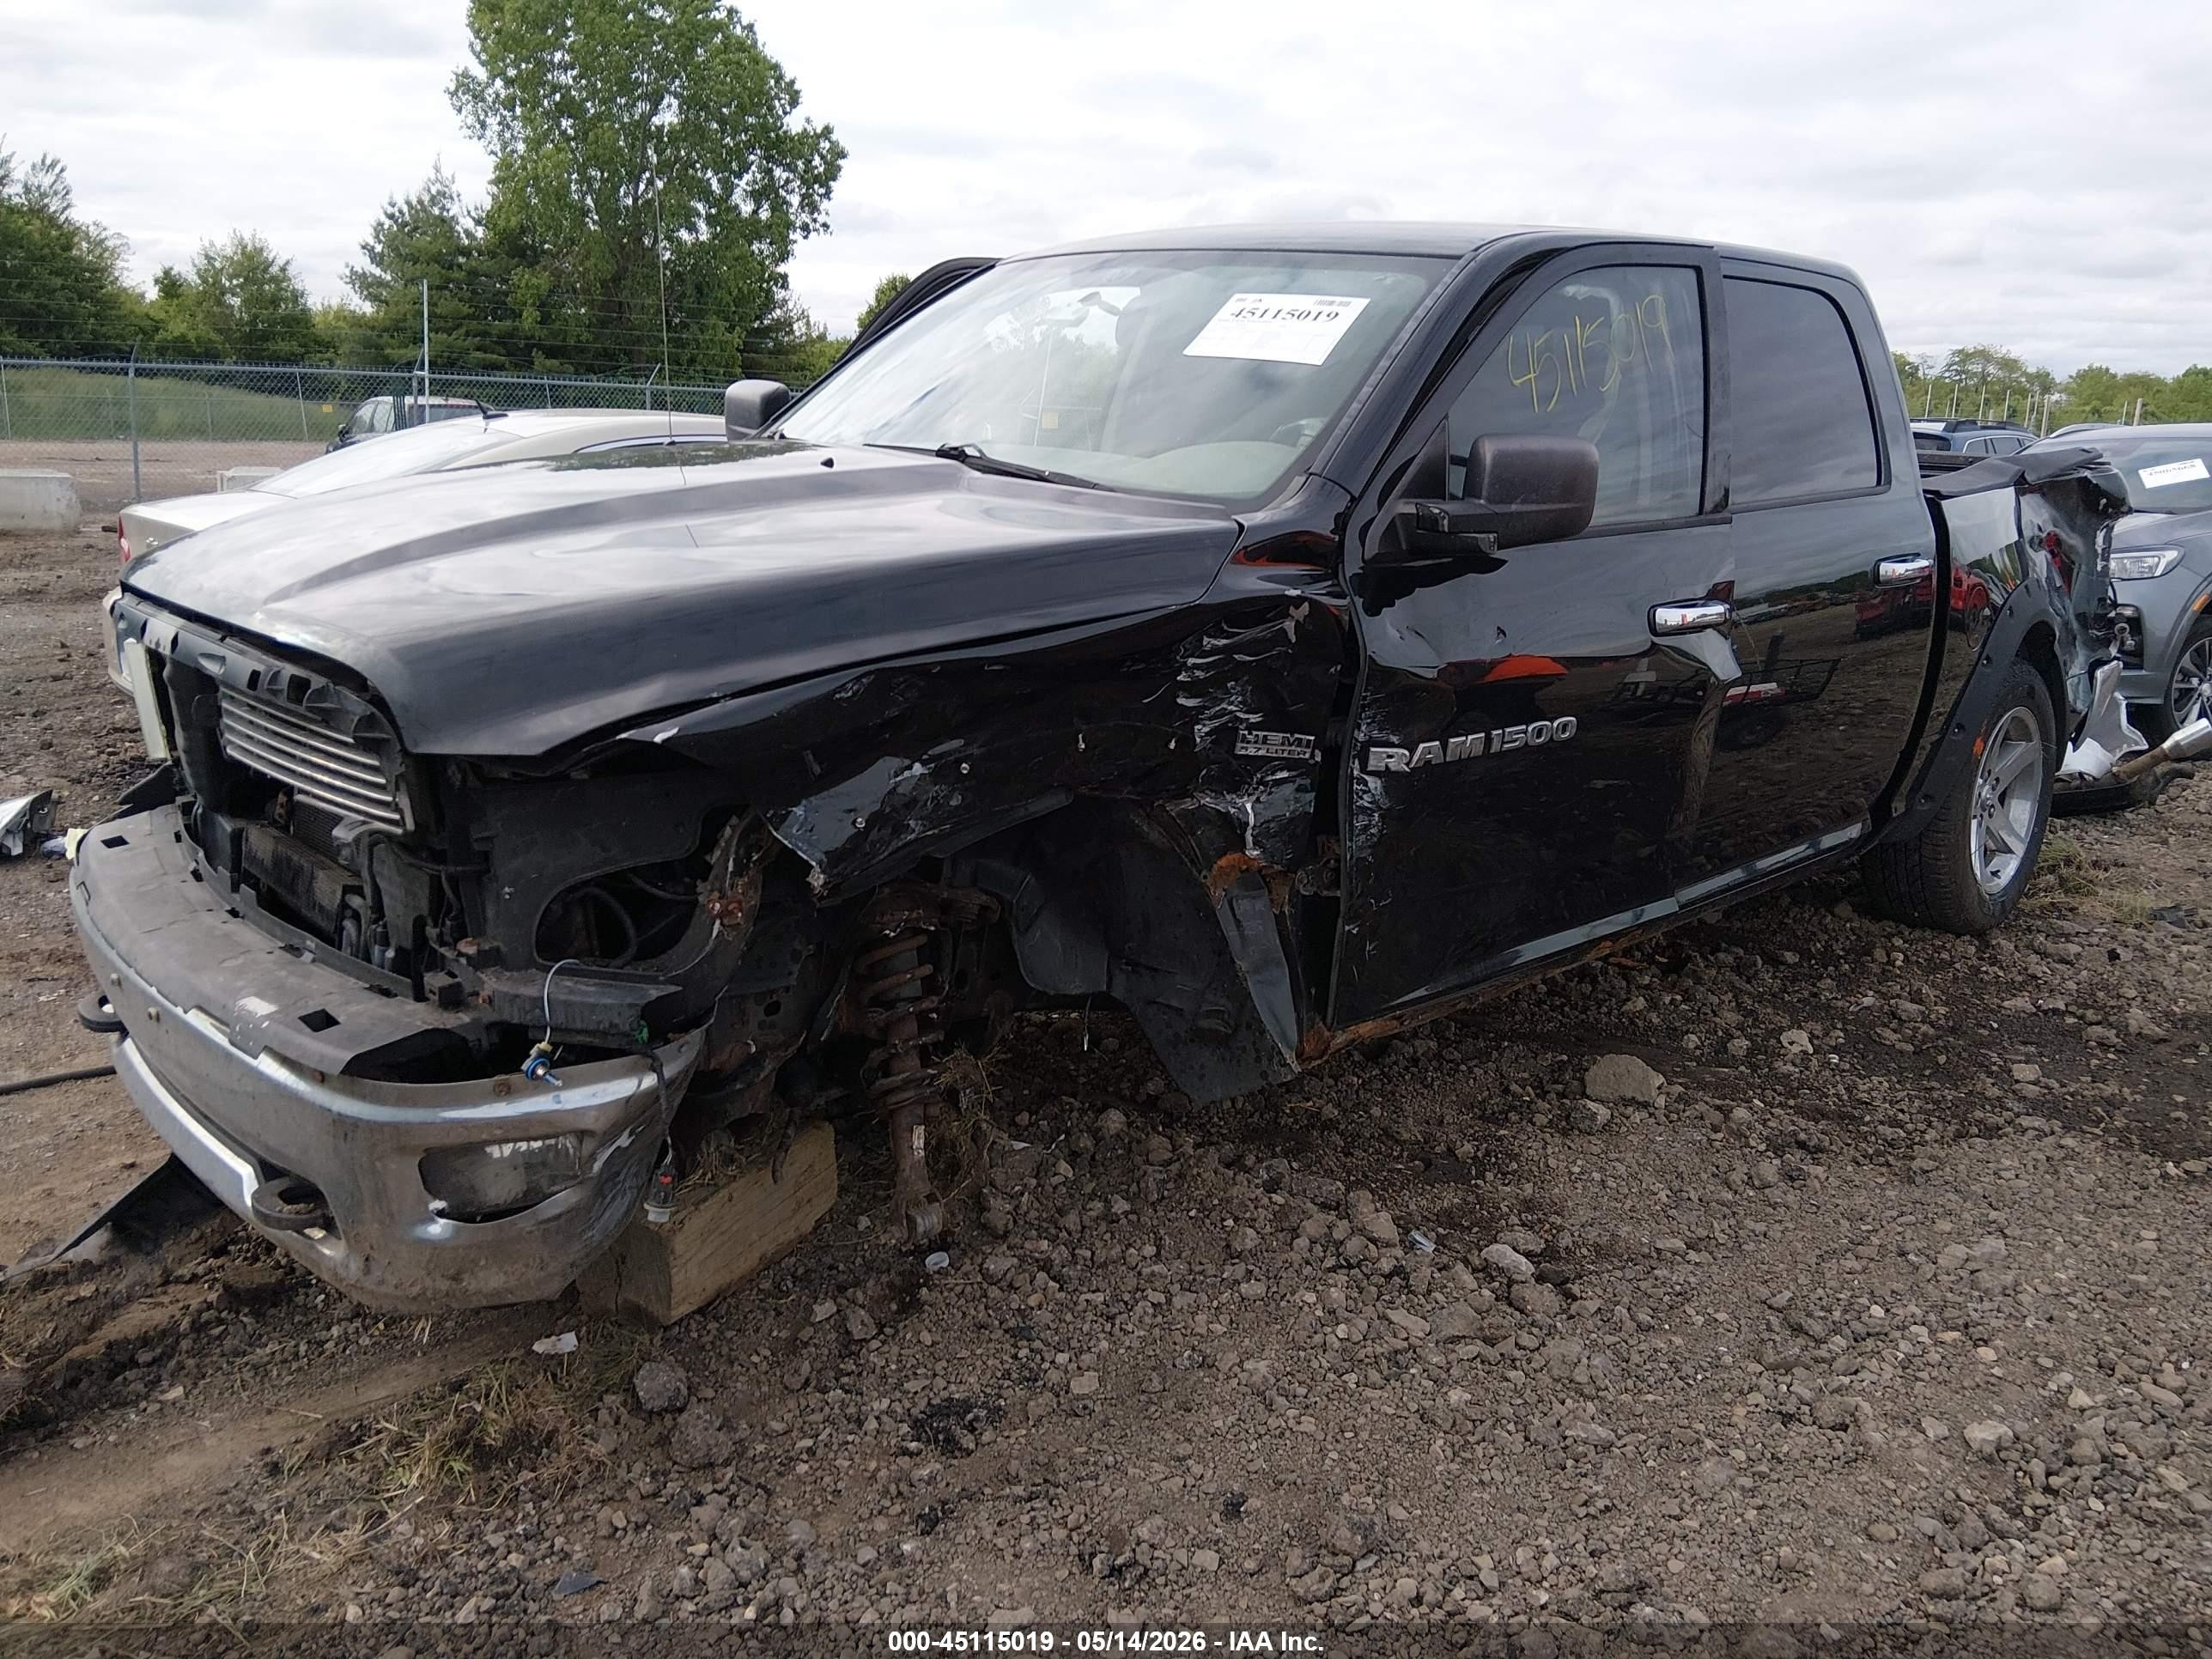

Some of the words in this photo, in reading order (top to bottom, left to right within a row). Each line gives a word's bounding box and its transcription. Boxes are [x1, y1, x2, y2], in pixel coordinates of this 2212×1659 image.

[1231, 307, 1340, 323] 45115019
[1509, 295, 1674, 413] 45115019
[1237, 731, 1315, 750] HEMI
[1366, 732, 1486, 772] RAM
[1490, 716, 1577, 754] 1500
[1265, 747, 1308, 757] LITER
